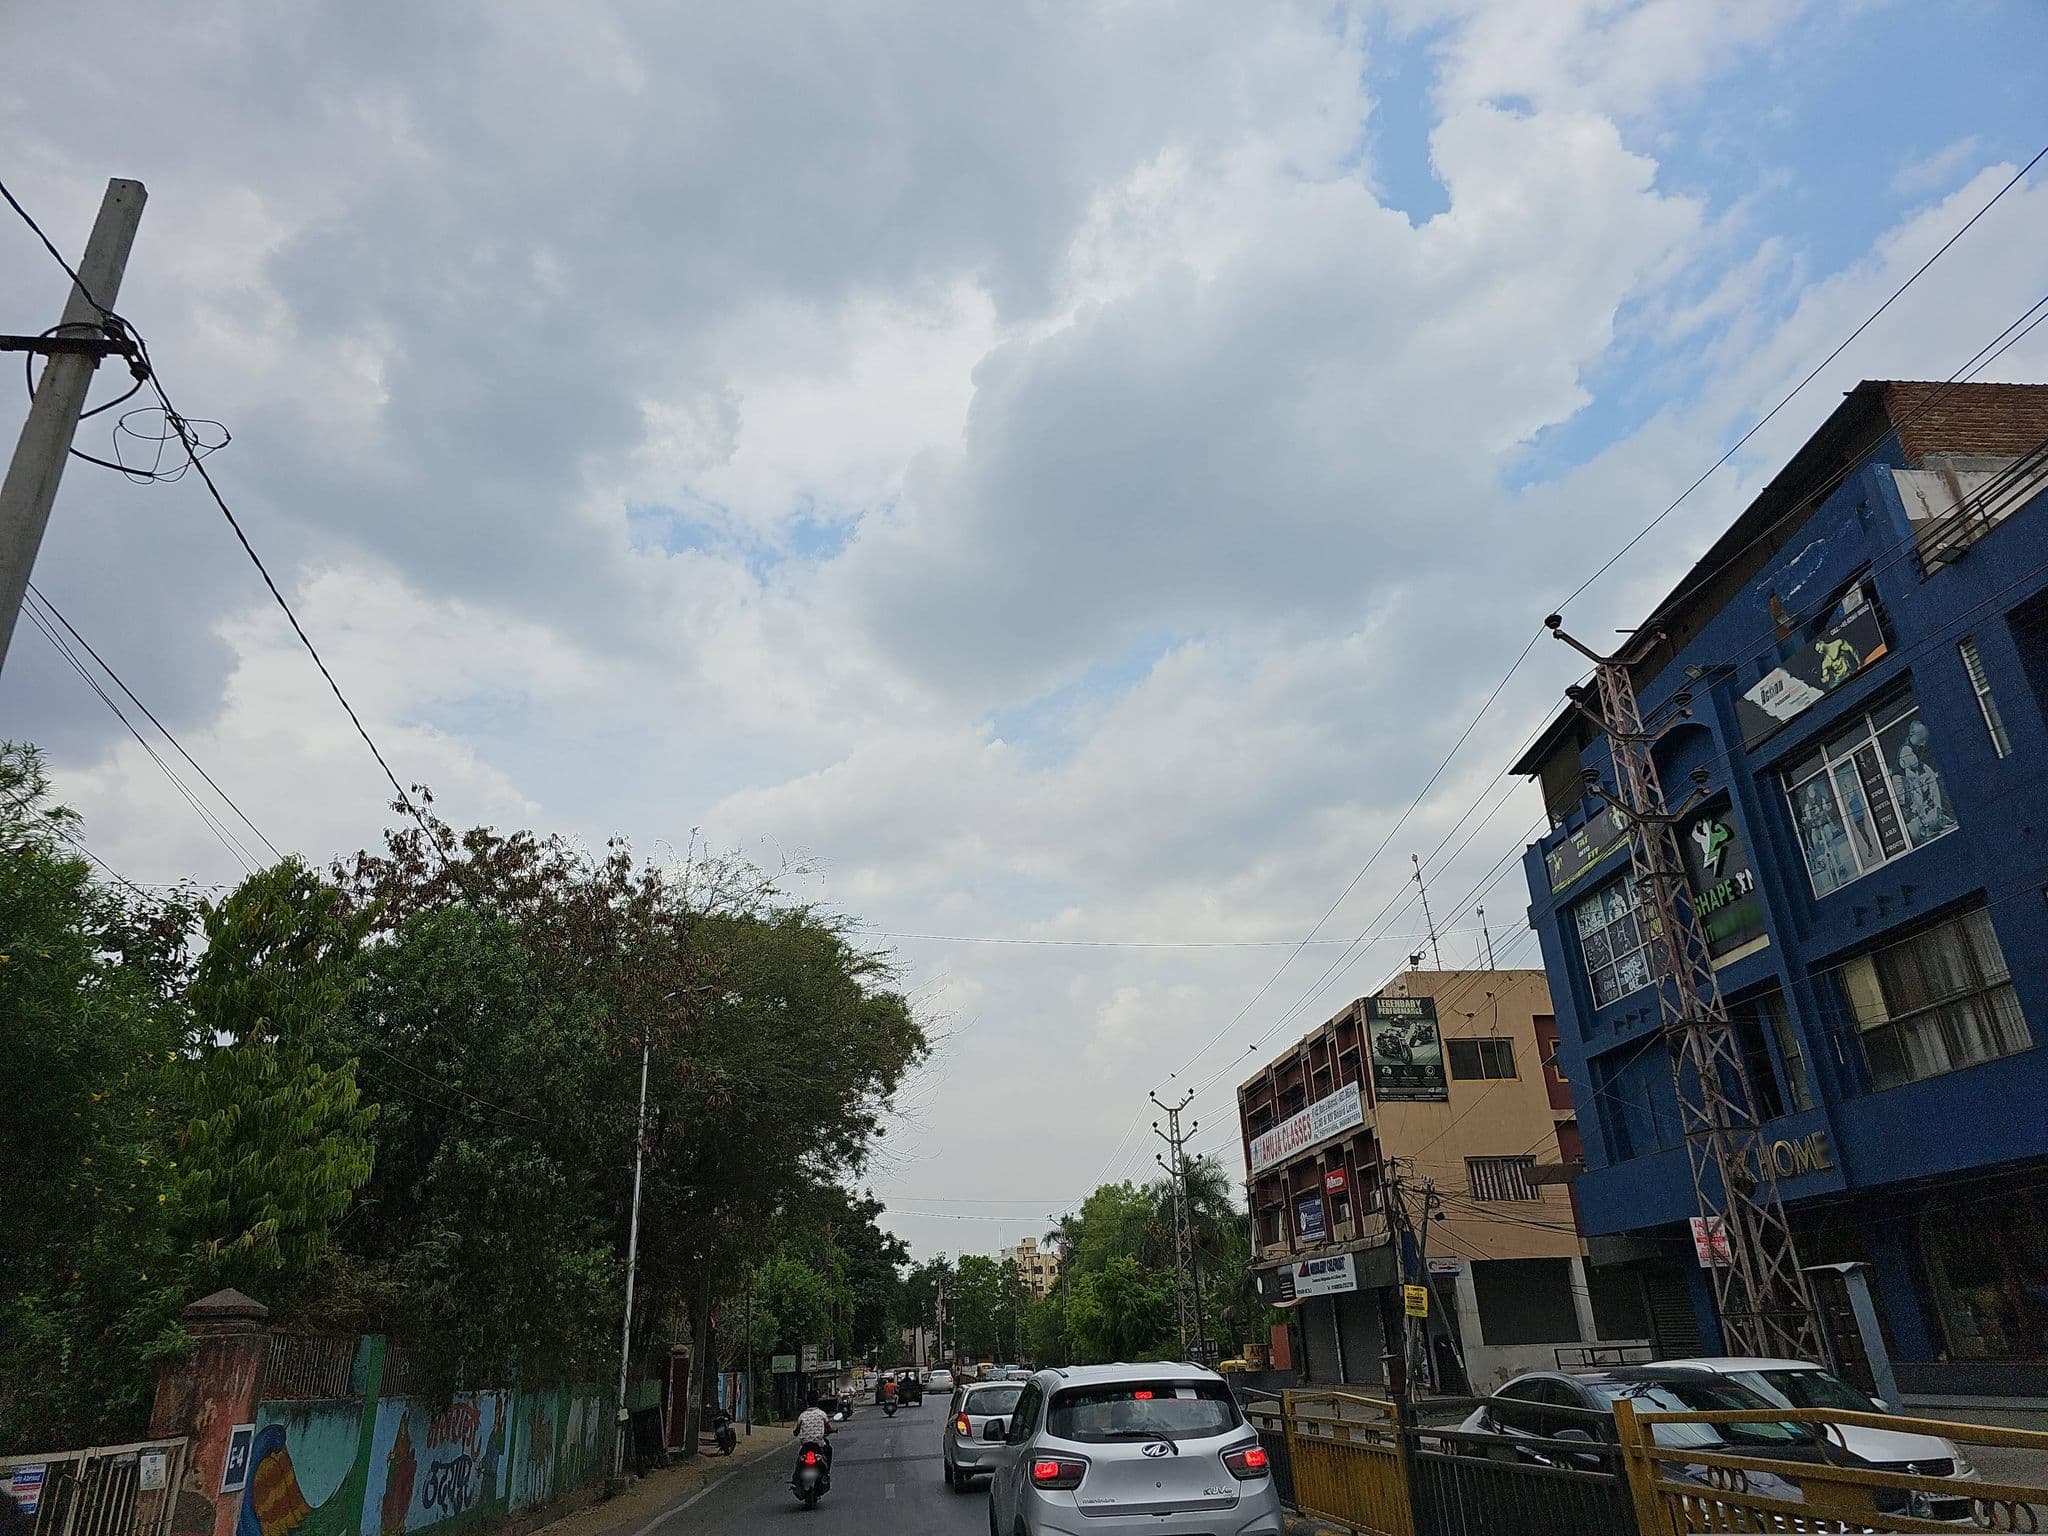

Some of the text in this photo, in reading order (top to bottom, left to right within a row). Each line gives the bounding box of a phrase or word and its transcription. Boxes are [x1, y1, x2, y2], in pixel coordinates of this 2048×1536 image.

[1885, 828, 1896, 838] ARE
[1576, 835, 1589, 849] FAT
[1587, 847, 1599, 860] FIT
[1376, 999, 1421, 1008] LEGENDARY
[1346, 1102, 1358, 1113] Level
[1262, 1130, 1283, 1162] AHUJA
[1283, 1114, 1312, 1153] CLASSES
[1755, 1129, 1834, 1181] HOME
